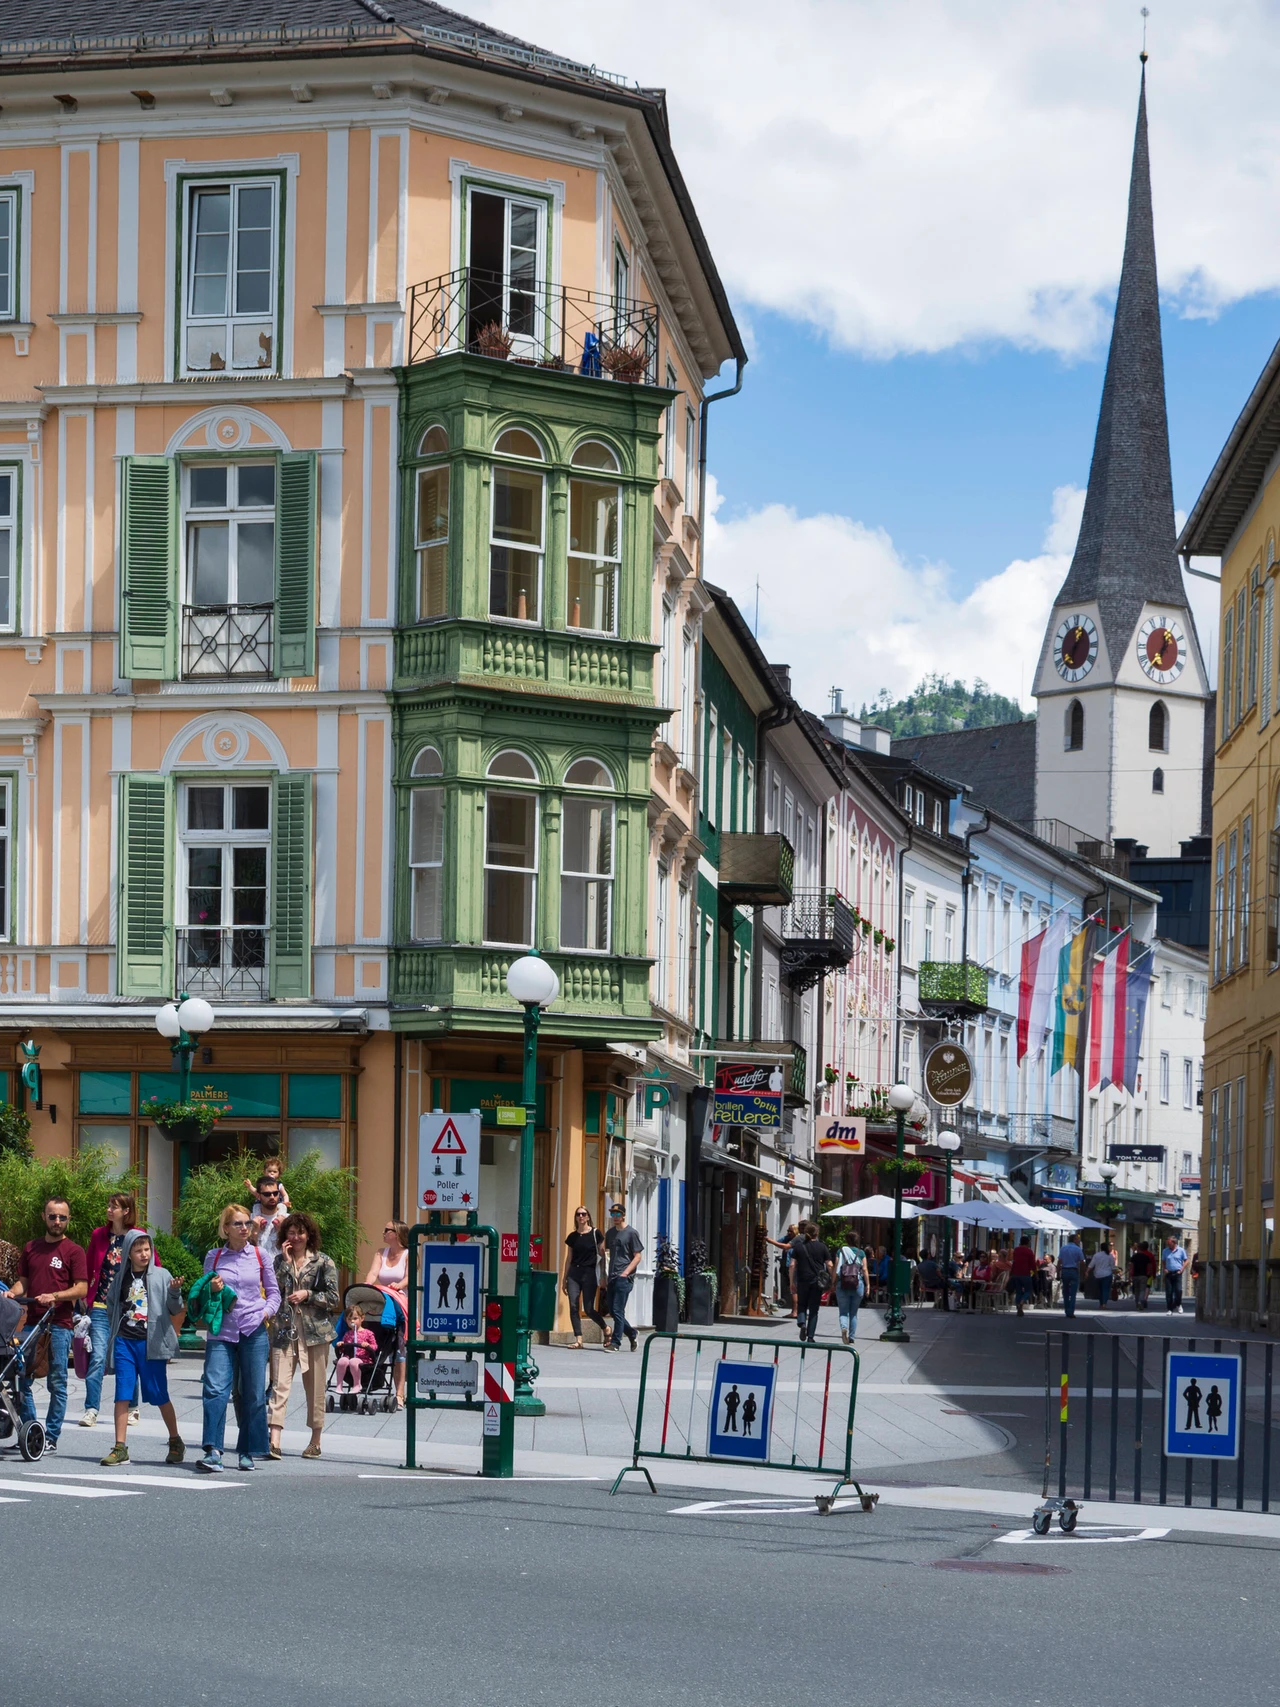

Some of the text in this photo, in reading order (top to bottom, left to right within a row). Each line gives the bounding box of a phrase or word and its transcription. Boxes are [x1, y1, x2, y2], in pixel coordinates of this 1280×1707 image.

[480, 1099, 515, 1107] PALMERS
[715, 1101, 744, 1111] brillen
[753, 1097, 778, 1113] Optik
[714, 1110, 780, 1125] fellerer
[826, 1121, 856, 1140] dm
[437, 1181, 459, 1189] Poller
[423, 1193, 437, 1201] STOP
[442, 1193, 454, 1202] bei
[420, 1378, 476, 1388] Schrittgeschwindigkeit
